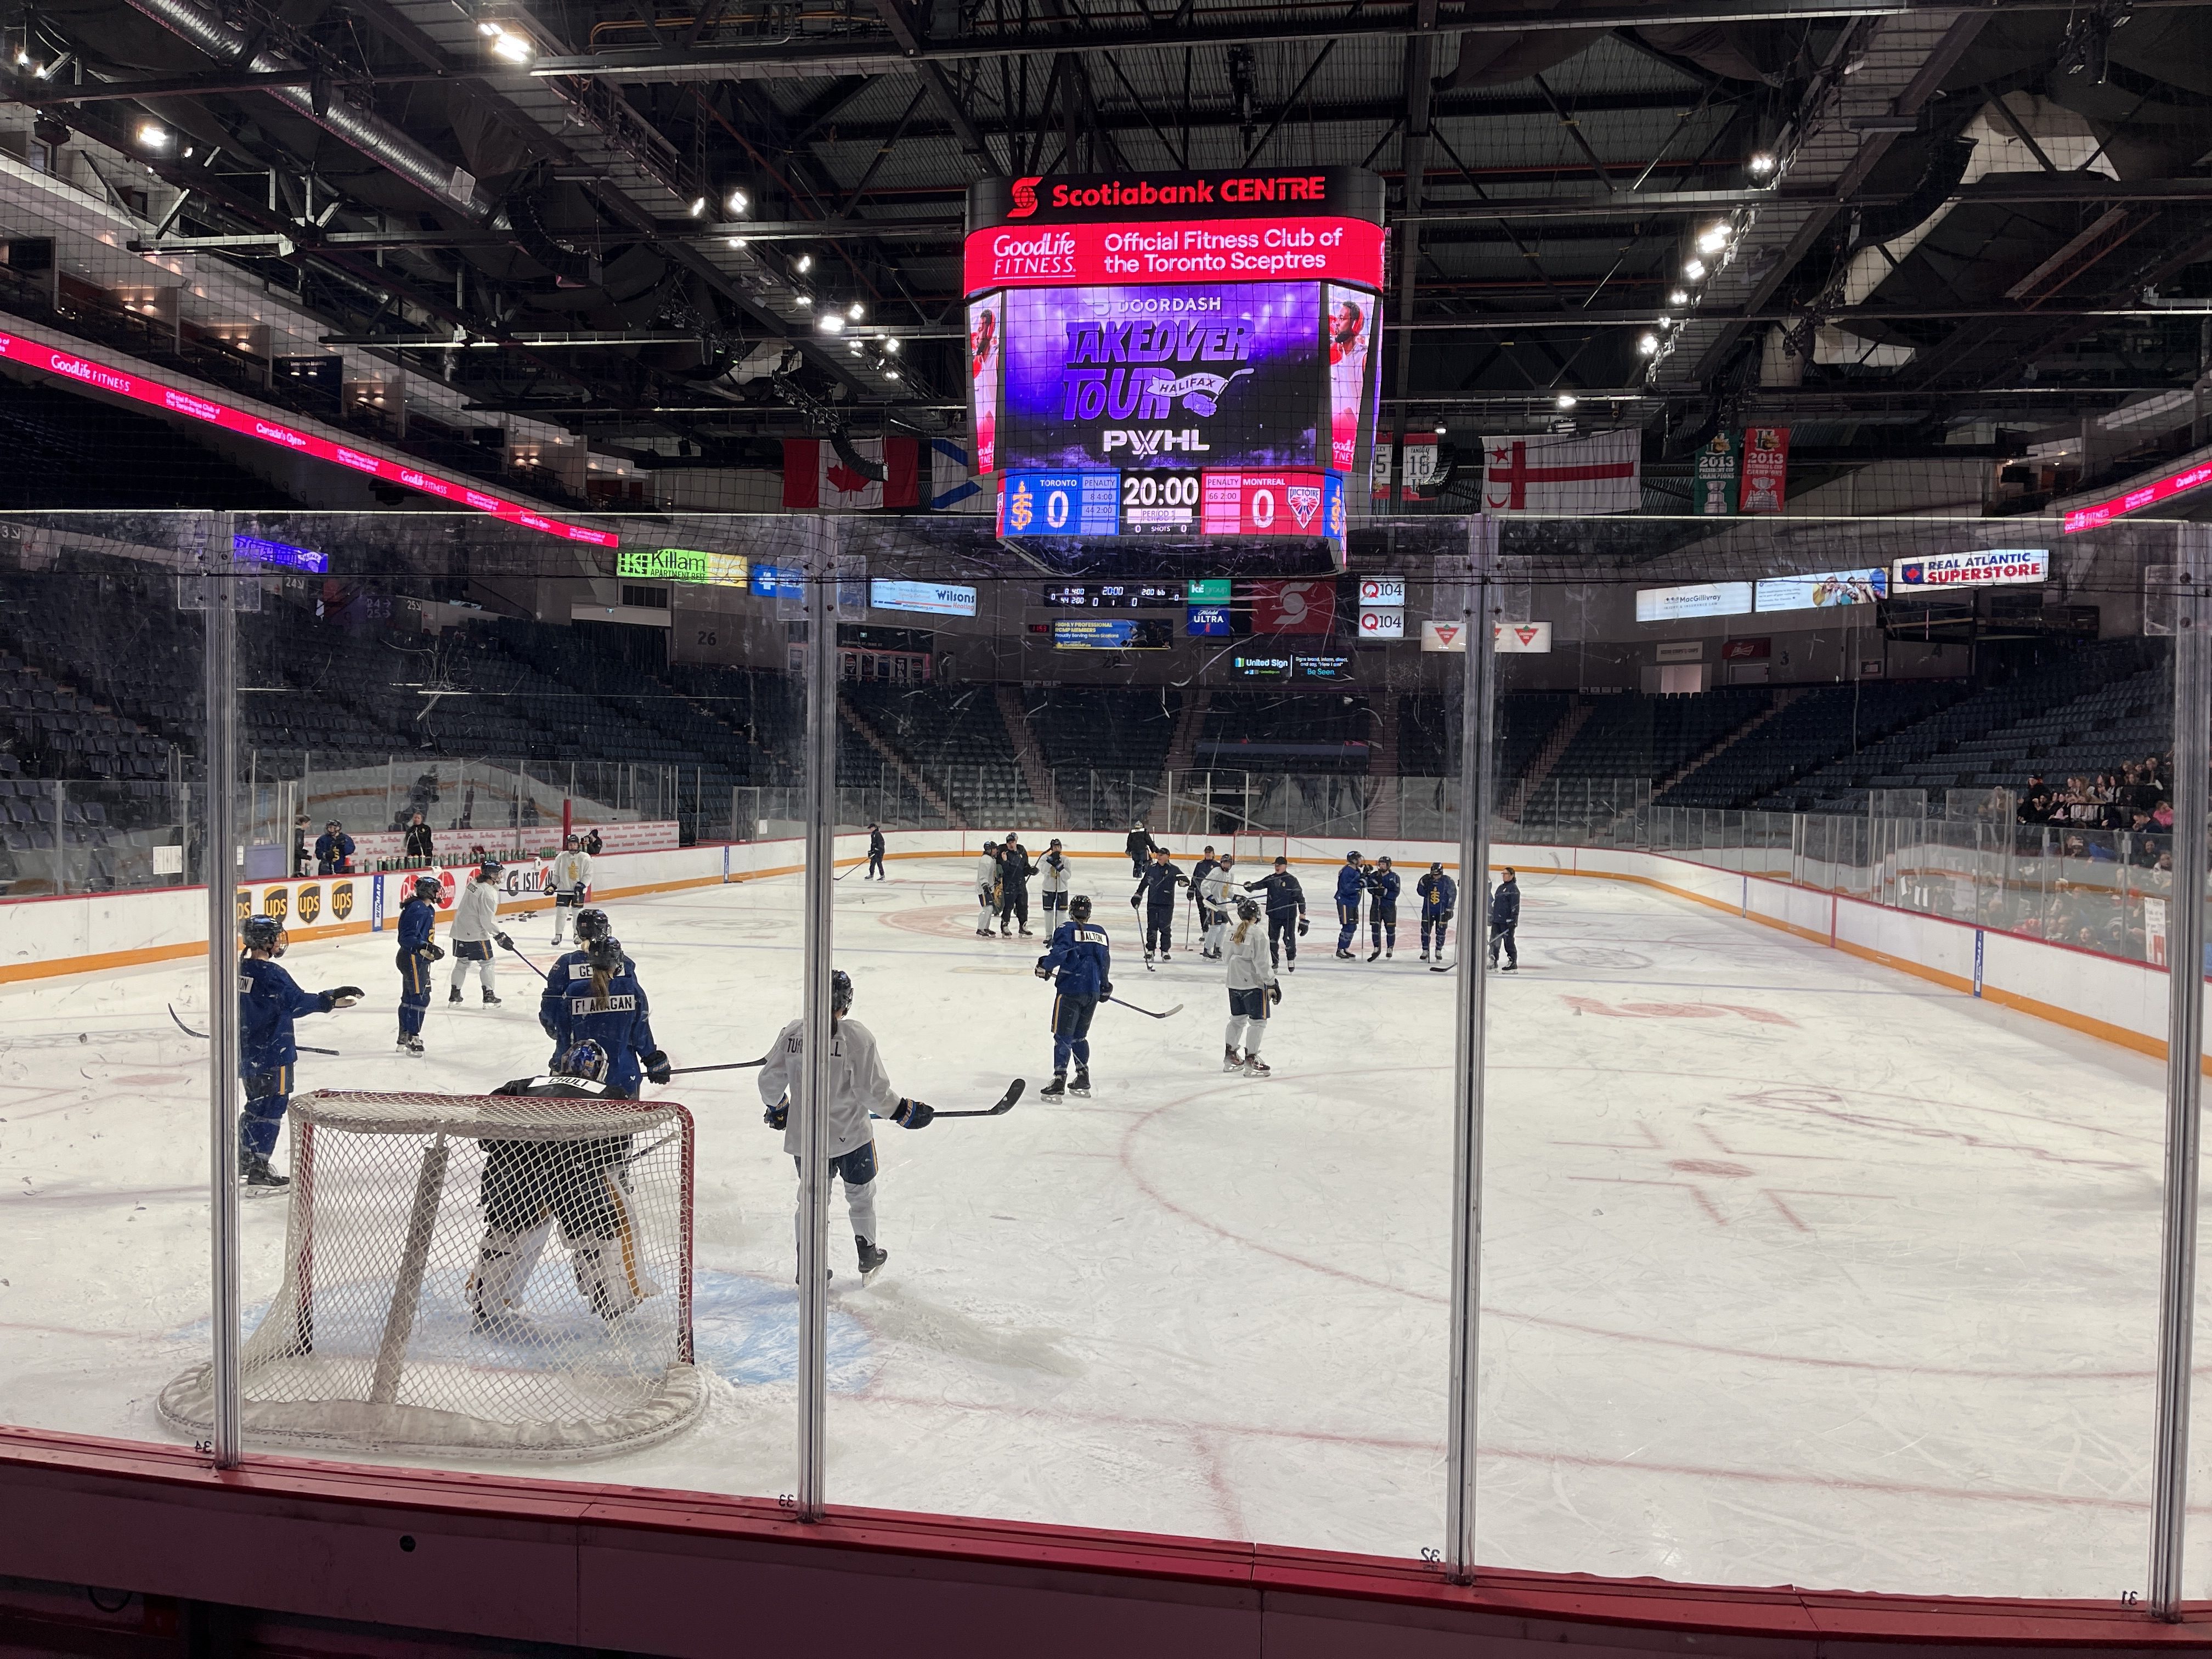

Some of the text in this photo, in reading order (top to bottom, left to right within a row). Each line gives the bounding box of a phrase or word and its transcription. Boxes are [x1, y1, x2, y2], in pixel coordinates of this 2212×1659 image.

[1053, 177, 1325, 207] Scotiabank CENTRE
[994, 232, 1075, 257] GoodLife
[1104, 227, 1343, 252] Official Fitness Club of
[1104, 251, 1326, 274] the Toronto Sceptres
[1118, 297, 1221, 313] DOORDASH
[1065, 319, 1255, 364] TAKEOVER
[51, 354, 131, 392] GoodLife FITNESS
[1159, 377, 1216, 393] HALIFAX
[1103, 430, 1210, 455] PWHL
[1410, 455, 1429, 476] 18
[1699, 456, 1734, 467] 2013
[1747, 453, 1783, 464] 2013
[1123, 477, 1199, 506] 20:00
[1047, 490, 1069, 527] 0
[1252, 489, 1274, 528] 0
[1135, 524, 1142, 533] 0
[1181, 524, 1187, 533] 0
[651, 550, 706, 572] Killam
[1928, 552, 2031, 570] REAL ATLANTIC
[1928, 562, 2040, 583] SUPERSTORE
[935, 589, 975, 603] Wilsons
[1102, 587, 1124, 596] 20:00
[1205, 587, 1228, 595] group
[1362, 580, 1402, 599] Q104
[1680, 594, 1721, 603] MacGillivray
[952, 602, 974, 611] Heating
[1093, 598, 1098, 606] 0
[1131, 598, 1137, 607] 0
[1362, 613, 1401, 630] Q104
[698, 631, 716, 646] 26
[1271, 659, 1288, 668] Sign
[1780, 650, 1789, 665] 3
[507, 870, 519, 896] G
[237, 901, 250, 919] ps
[266, 898, 286, 918] ups
[299, 895, 320, 919] ups
[332, 892, 352, 916] ups
[1082, 932, 1103, 943] ALTON
[548, 1077, 589, 1087] CHULI
